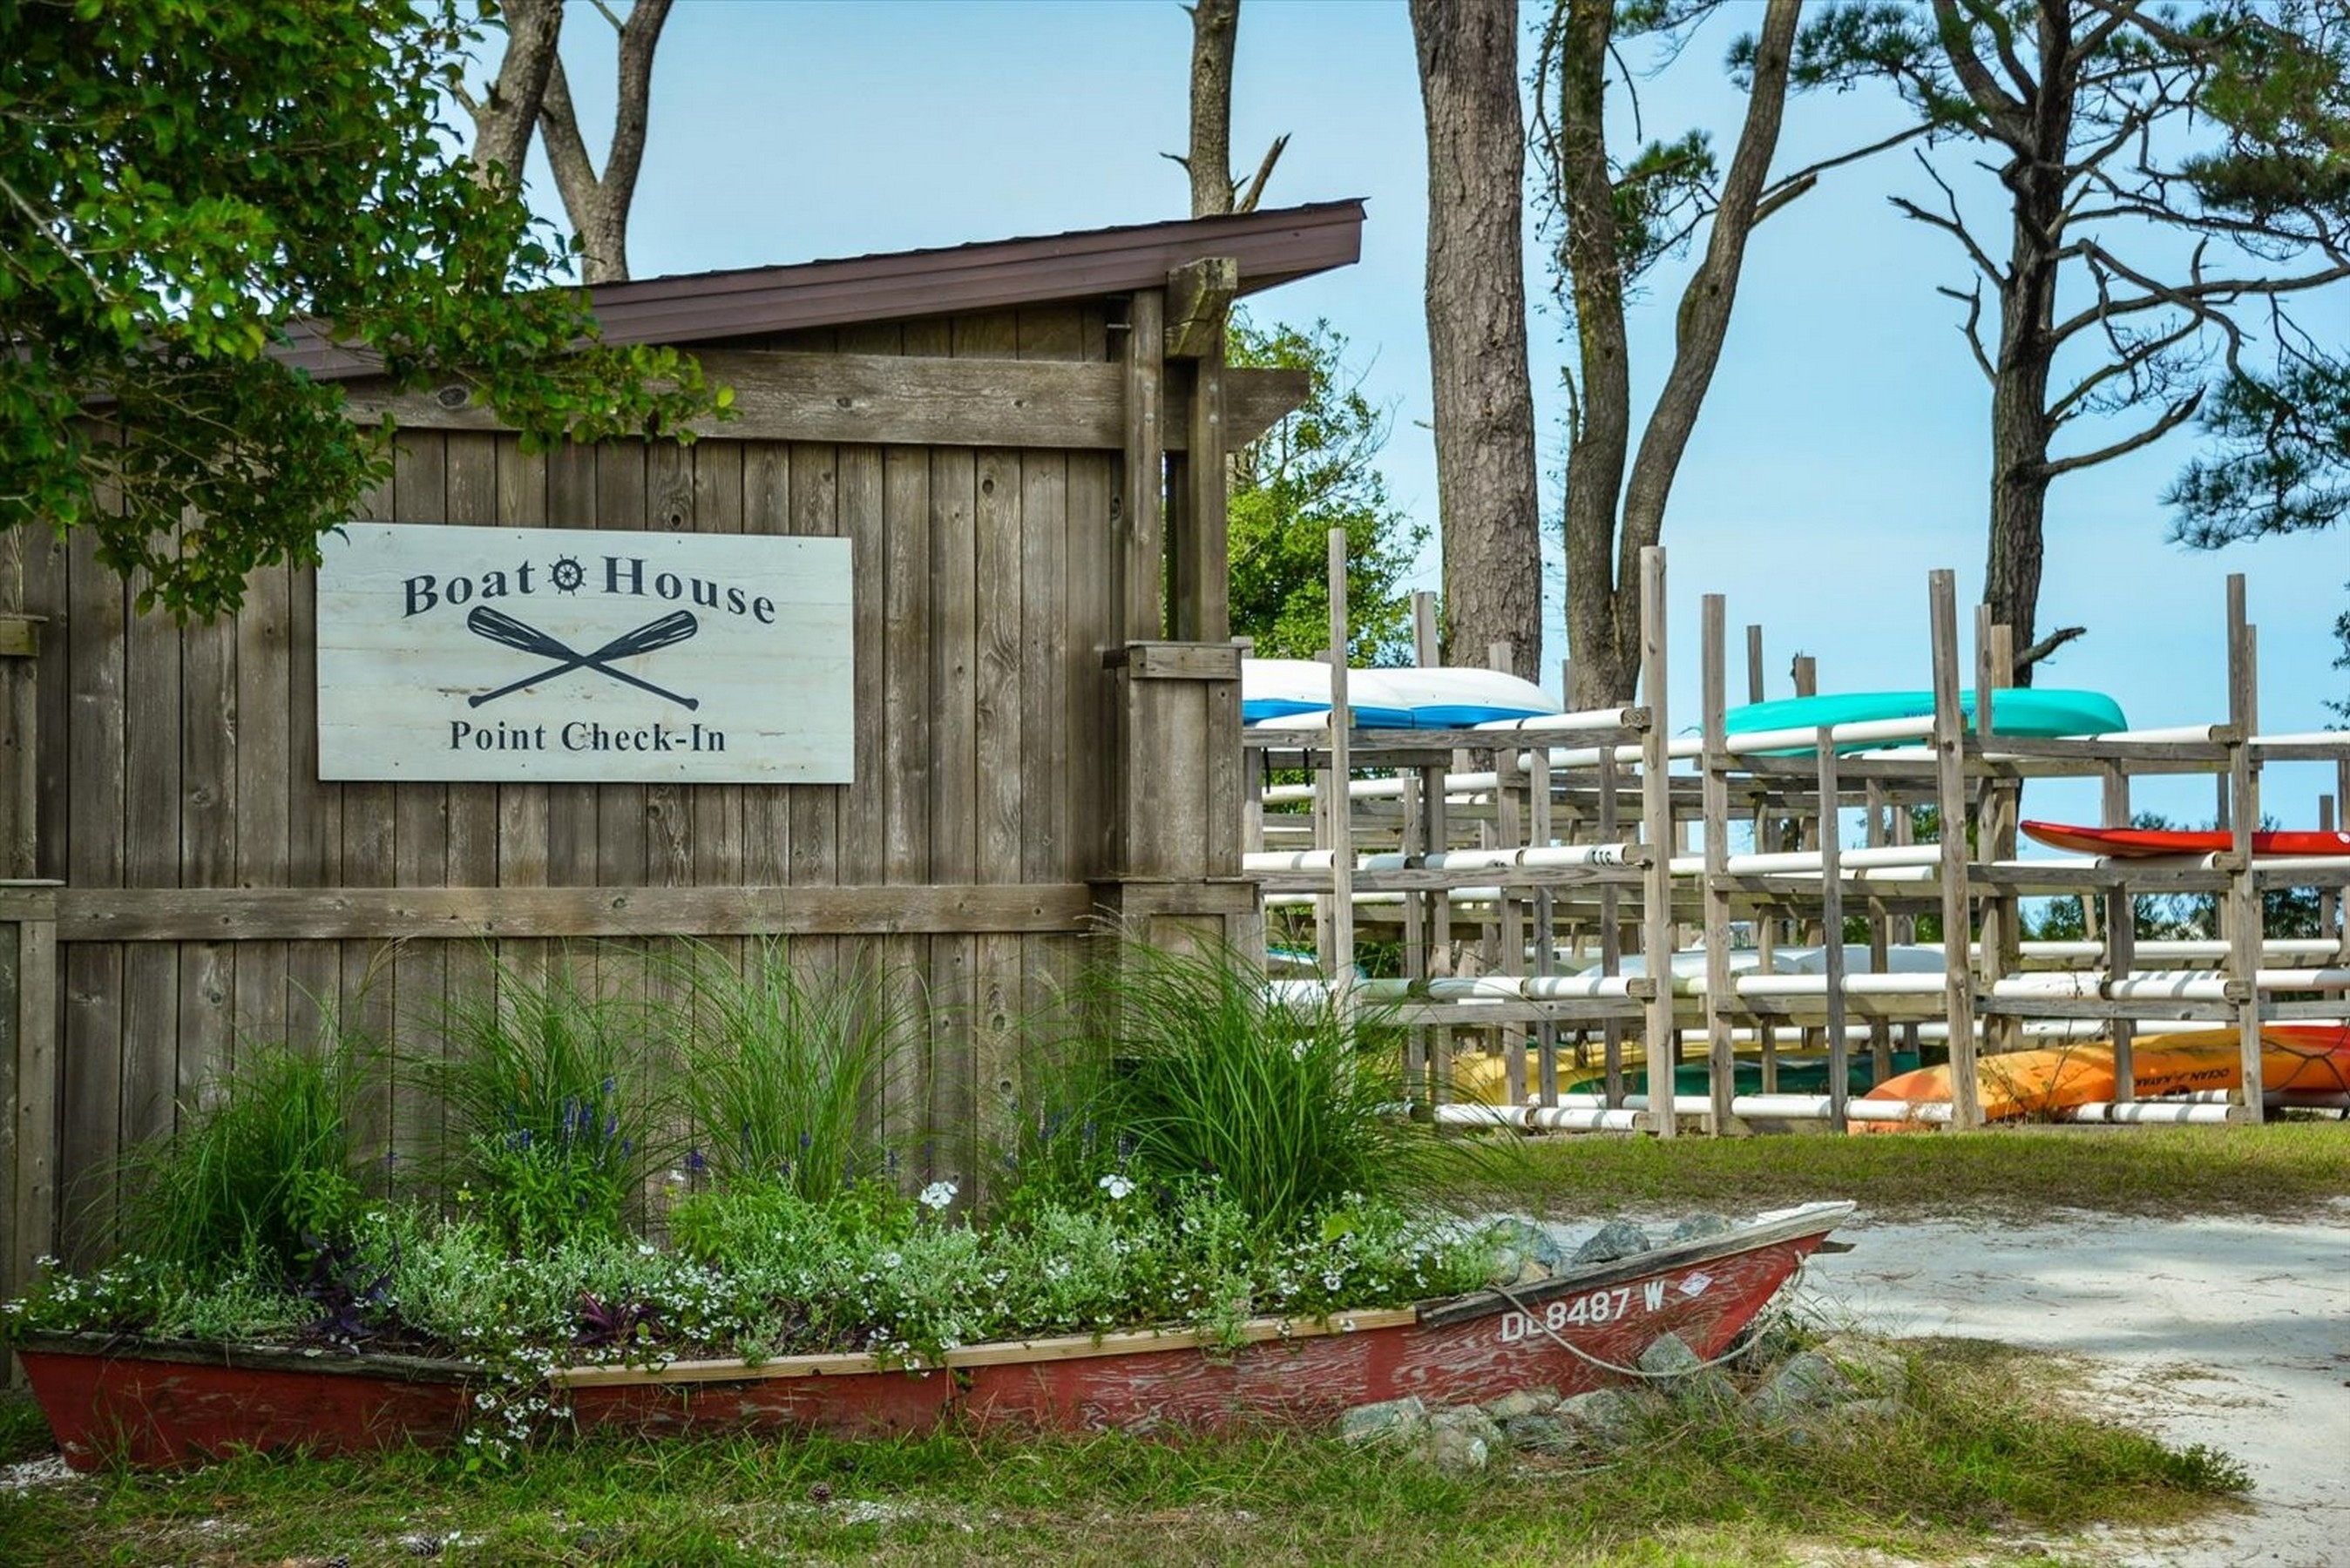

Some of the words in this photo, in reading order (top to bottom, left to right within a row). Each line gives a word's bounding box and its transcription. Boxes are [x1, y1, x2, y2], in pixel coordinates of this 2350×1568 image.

[402, 560, 536, 619] Boat
[600, 556, 776, 625] House
[450, 720, 546, 751] Point
[561, 721, 726, 753] Check-In
[1643, 1280, 1665, 1312] W
